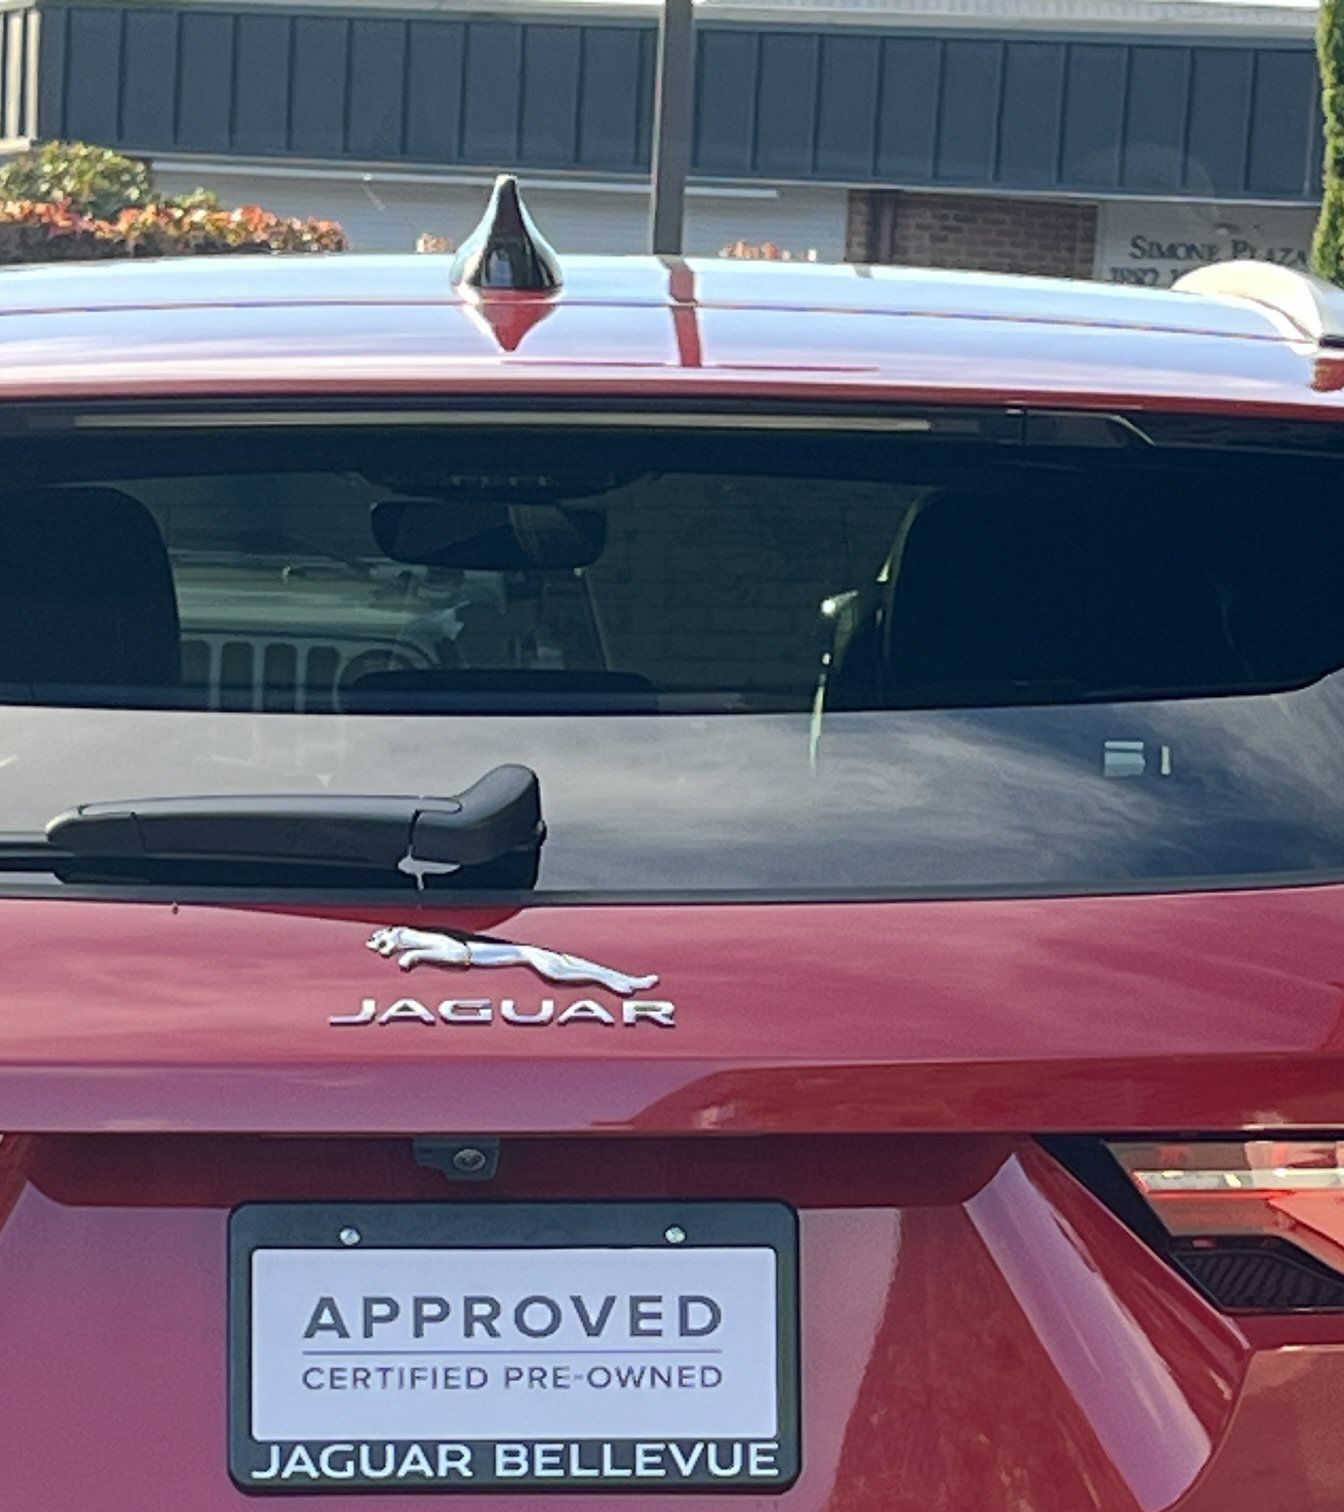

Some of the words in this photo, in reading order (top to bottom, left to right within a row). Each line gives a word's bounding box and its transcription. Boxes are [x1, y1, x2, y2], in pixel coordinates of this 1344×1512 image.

[327, 998, 676, 1026] JAGUAR
[302, 1295, 722, 1339] APPROVED
[302, 1365, 489, 1391] CERTIFIED
[503, 1364, 723, 1391] PRE-OWNED
[251, 1443, 474, 1480] JAGUAR
[494, 1442, 780, 1478] BELLEVUE
